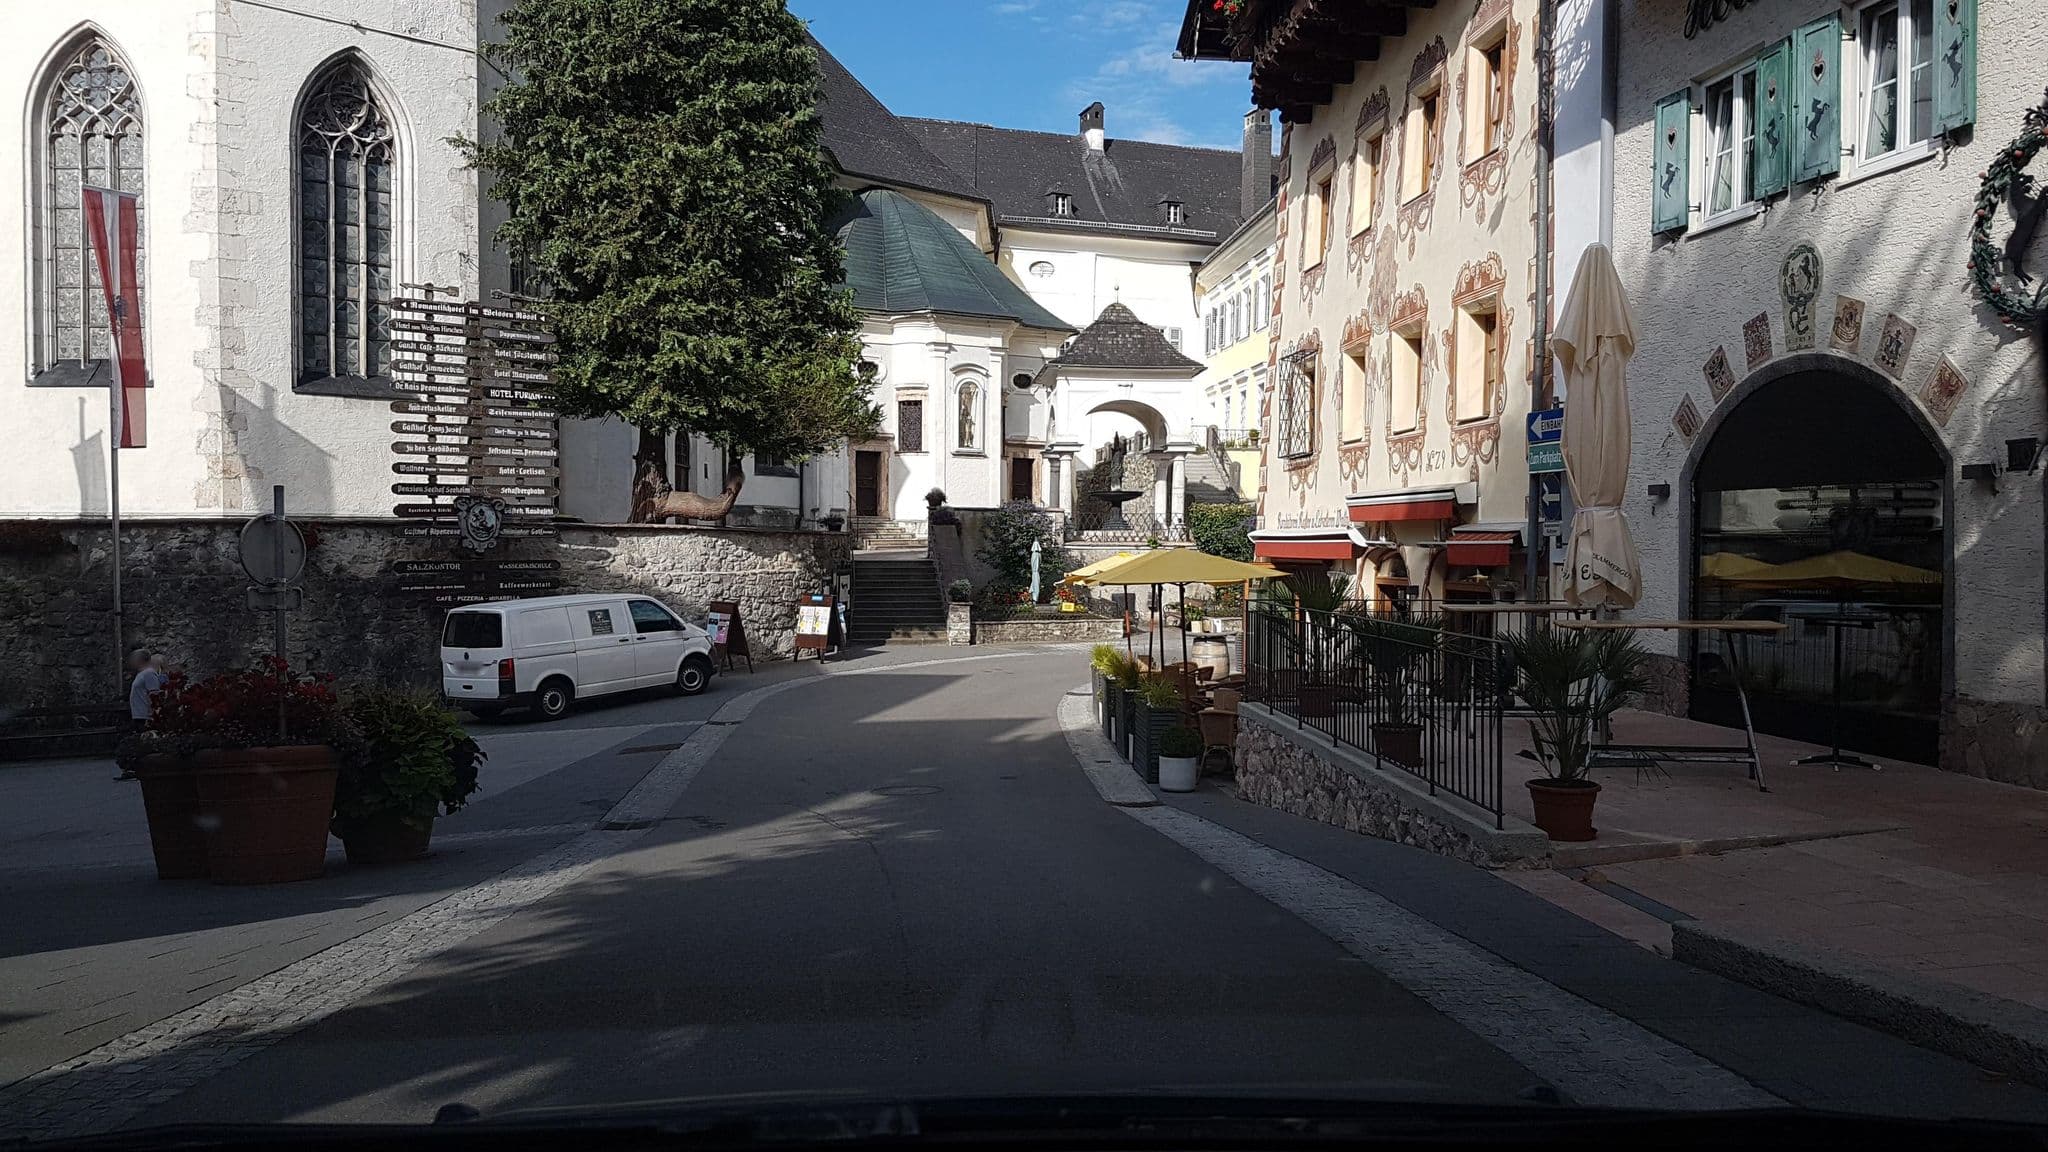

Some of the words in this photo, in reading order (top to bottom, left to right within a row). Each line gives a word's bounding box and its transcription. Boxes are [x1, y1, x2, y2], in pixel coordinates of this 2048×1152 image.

[490, 389, 514, 399] HOTEL
[514, 390, 541, 400] FURIAN
[406, 563, 461, 571] SALZKONTOR
